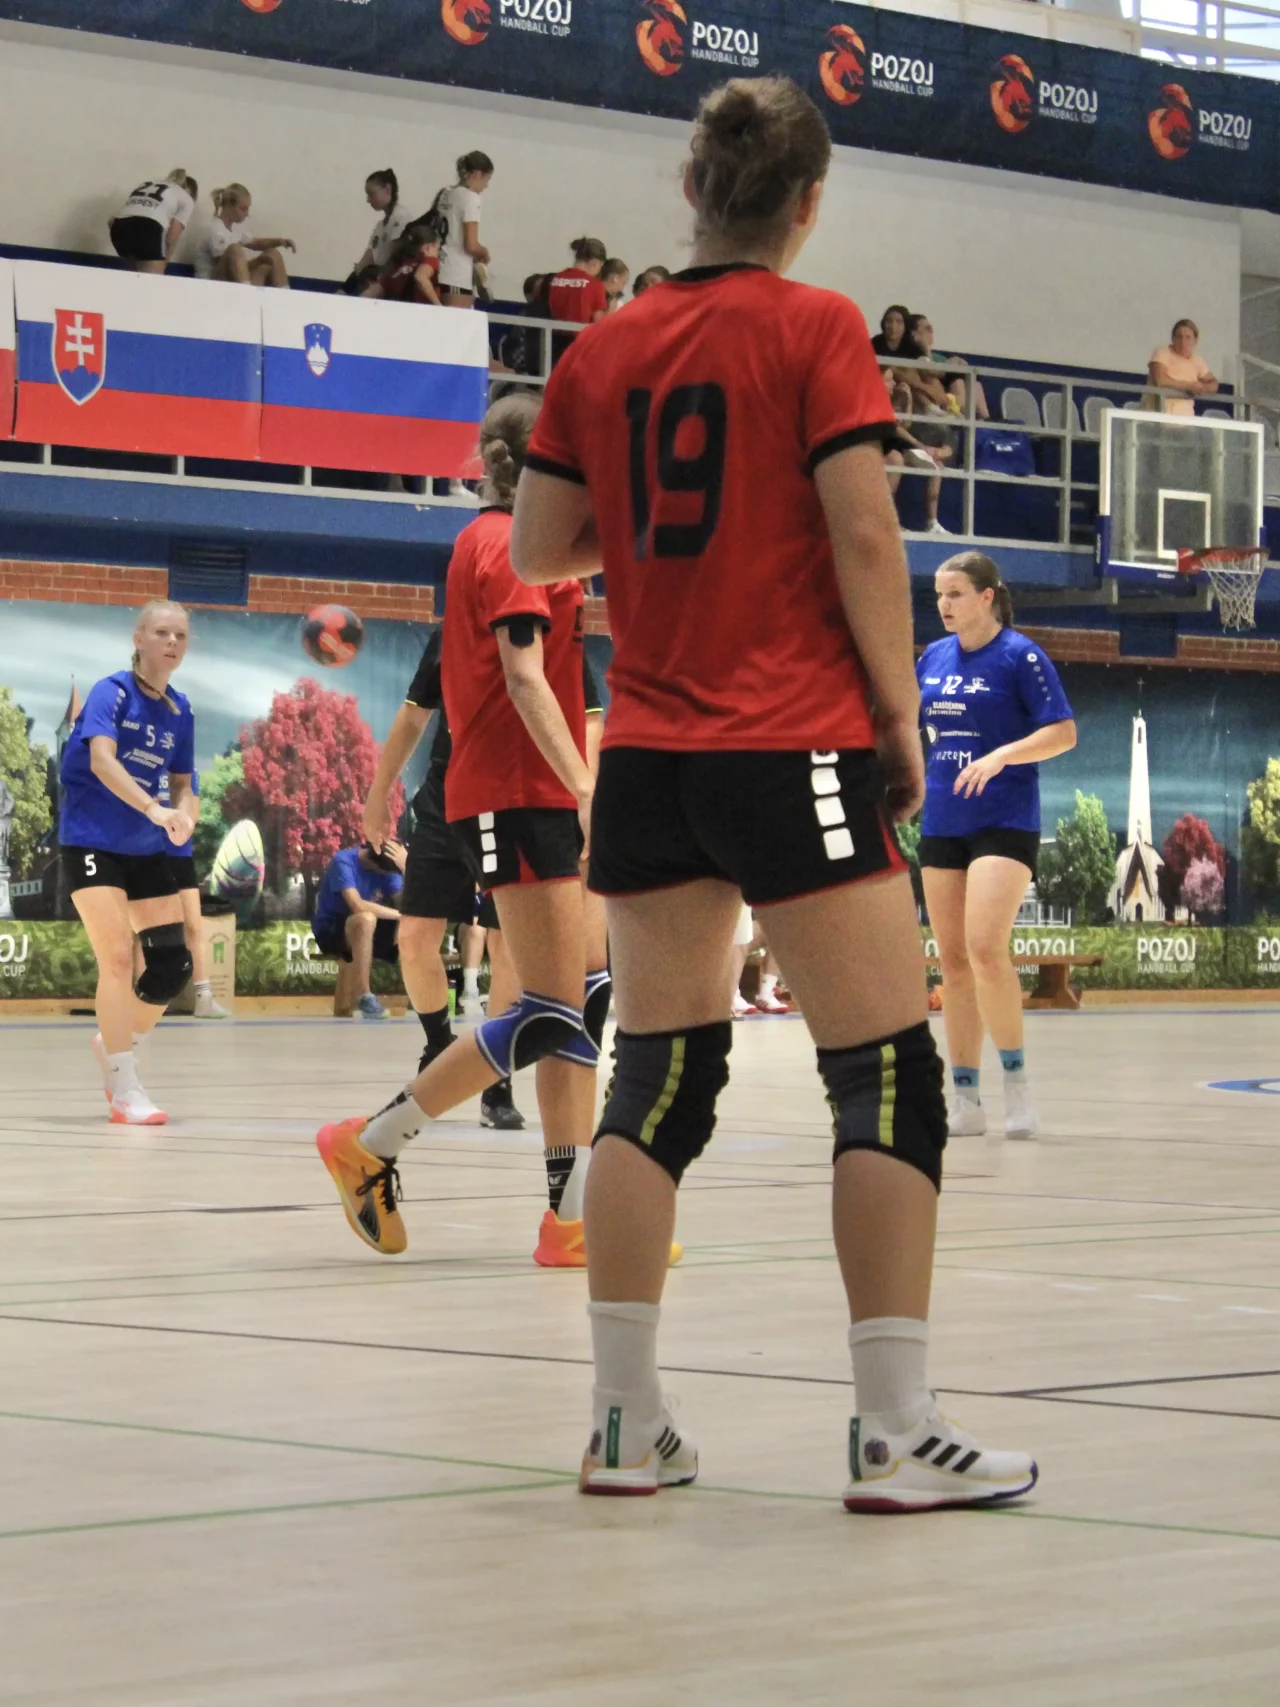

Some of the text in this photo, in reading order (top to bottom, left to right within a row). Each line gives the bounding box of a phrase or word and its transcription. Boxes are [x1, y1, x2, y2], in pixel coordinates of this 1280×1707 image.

[500, 0, 571, 24] POZOJ
[500, 17, 571, 36] HANDBALL CUP
[692, 21, 758, 56] POZOJ
[692, 48, 759, 67] HANDBALL CUP
[871, 52, 933, 85] POZOJ
[872, 79, 934, 97] HANDBALL CUP
[1039, 81, 1098, 112] POZOJ
[1039, 107, 1097, 124] HANDBALL CUP
[1199, 109, 1252, 140] POZOJ
[129, 181, 169, 202] 21
[626, 381, 727, 561] 19
[941, 675, 963, 695] 12
[146, 724, 156, 748] 5
[85, 854, 97, 877] 5
[1137, 937, 1196, 961] POZOJ
[3, 965, 26, 978] CUP
